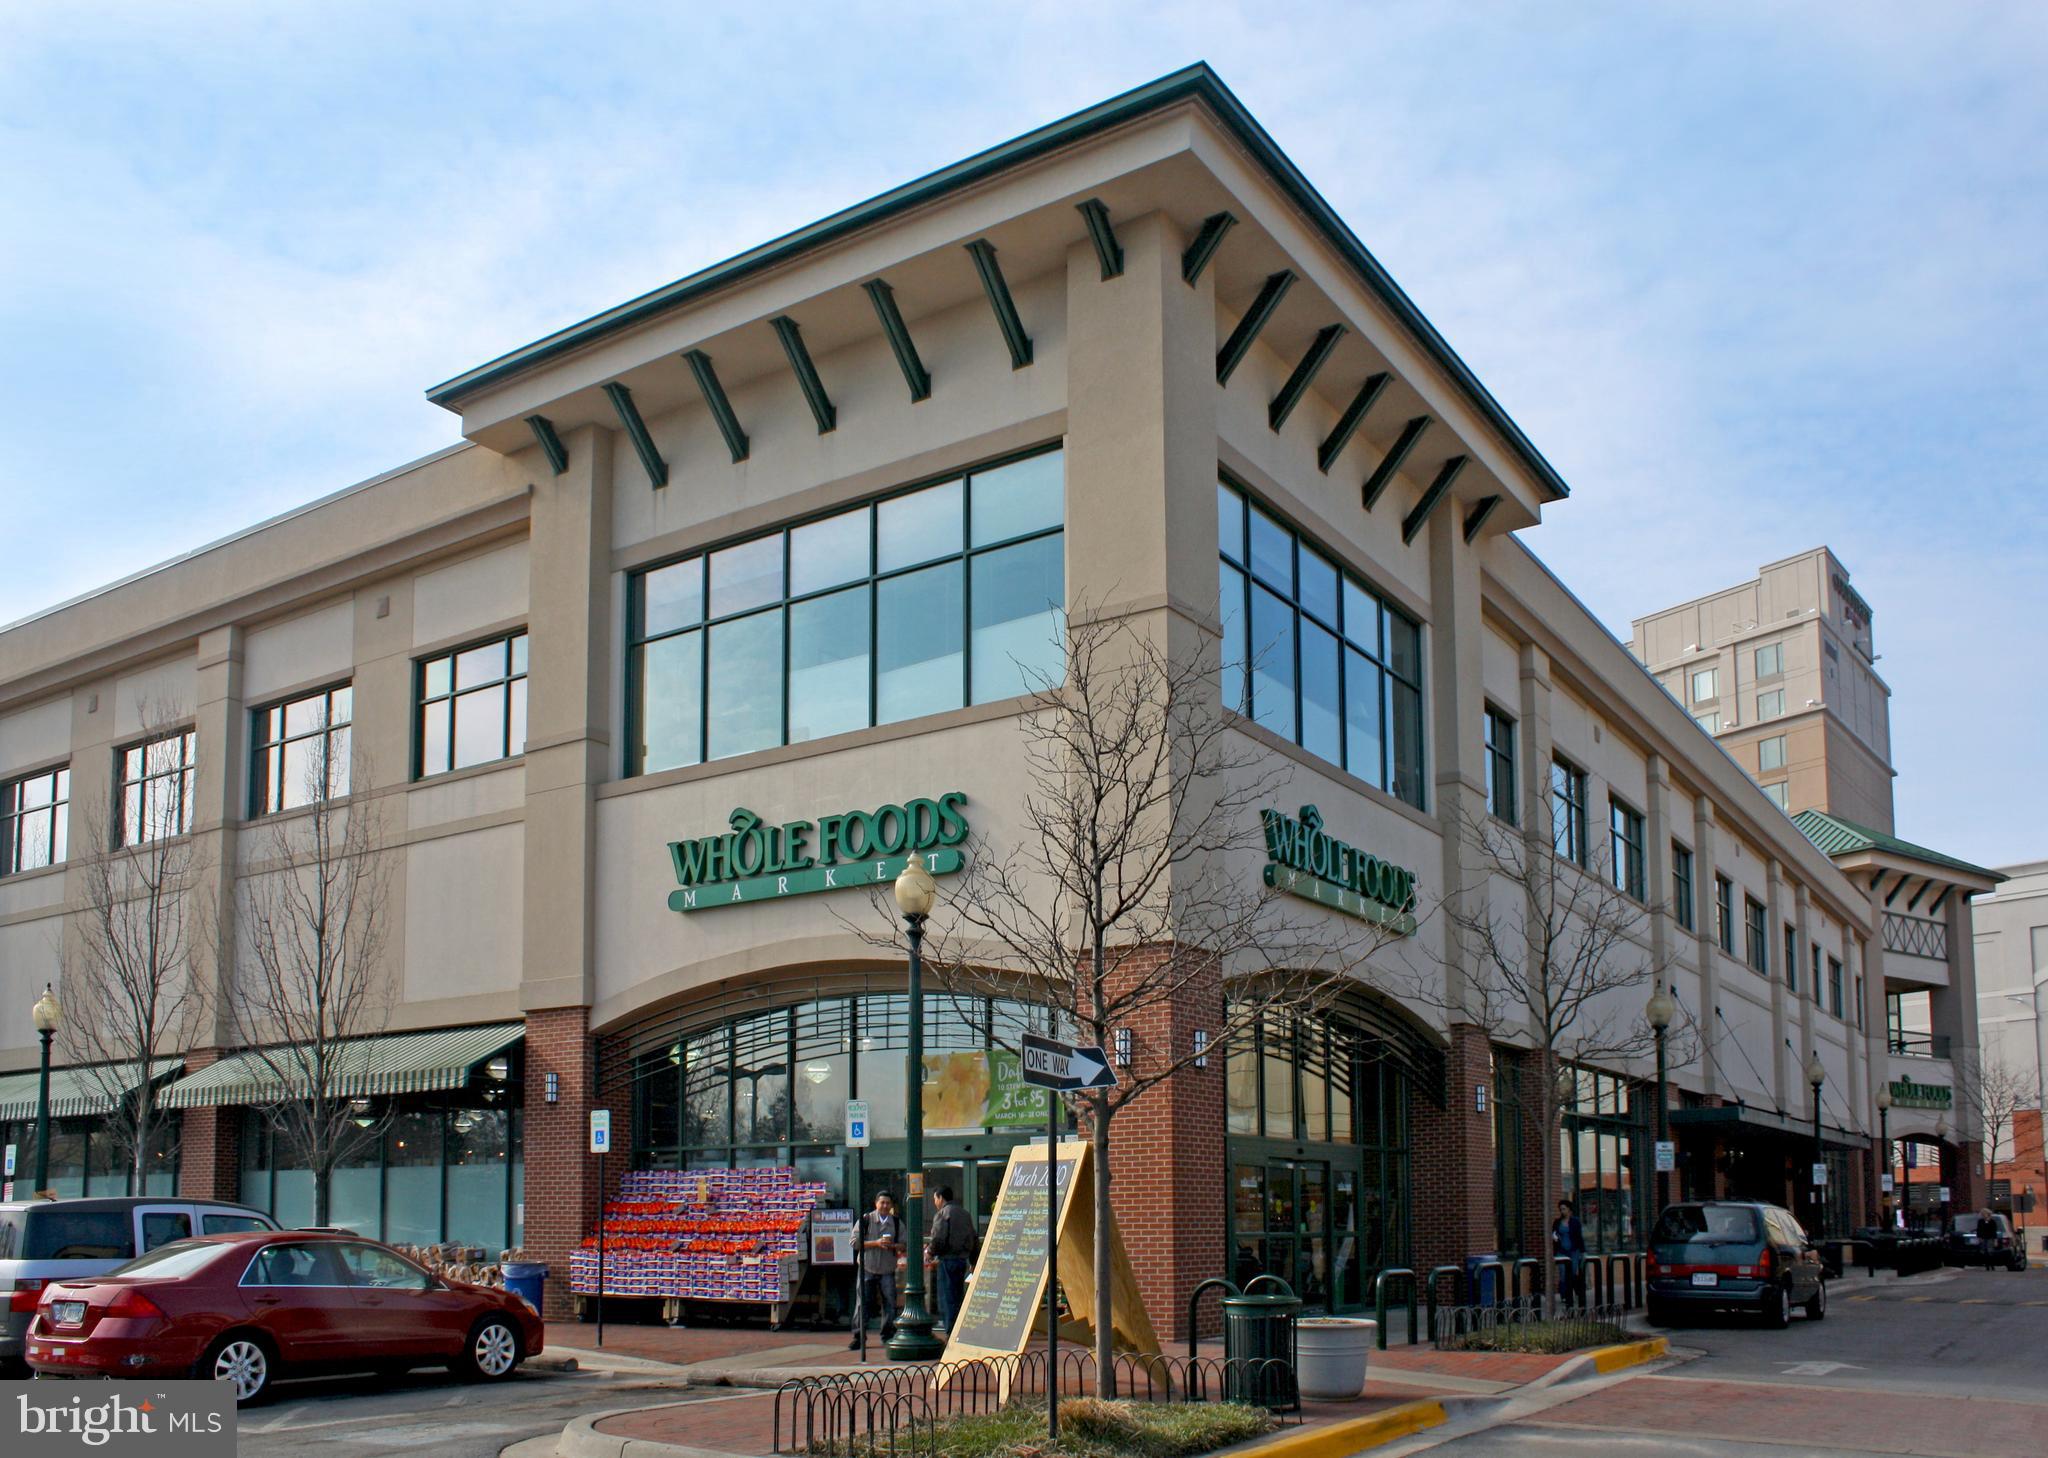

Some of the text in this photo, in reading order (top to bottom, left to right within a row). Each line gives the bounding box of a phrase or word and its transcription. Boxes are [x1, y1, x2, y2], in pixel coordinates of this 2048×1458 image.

[667, 792, 969, 885] WHOLE FOODS
[1261, 805, 1416, 912] WHOLE FOODS
[684, 853, 939, 906] MARKET
[1288, 872, 1405, 929] MARKET
[1027, 1049, 1069, 1076] ONE WAY
[1002, 1089, 1045, 1110] 3 for $5
[1009, 1164, 1038, 1187] March
